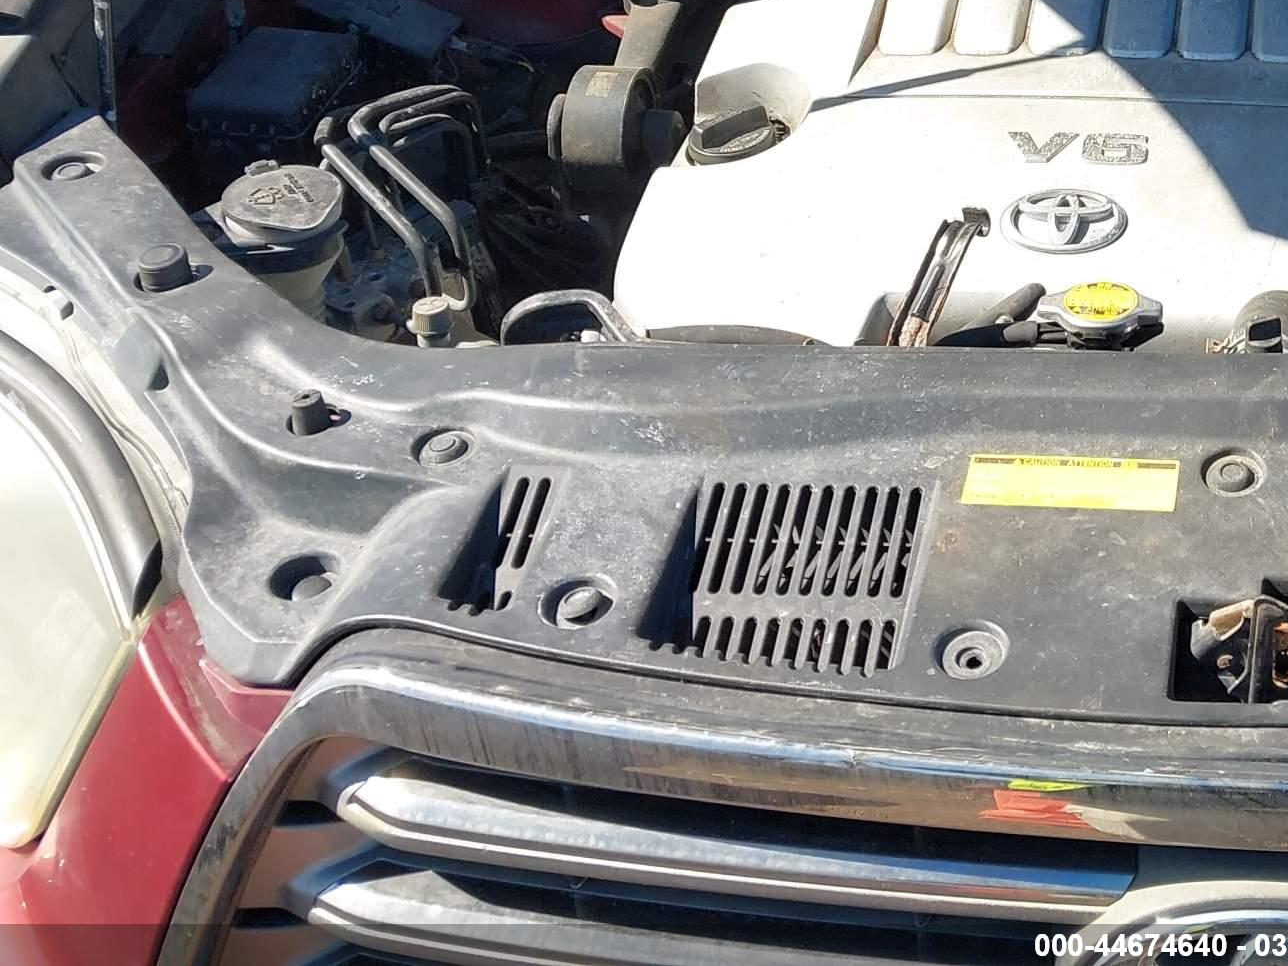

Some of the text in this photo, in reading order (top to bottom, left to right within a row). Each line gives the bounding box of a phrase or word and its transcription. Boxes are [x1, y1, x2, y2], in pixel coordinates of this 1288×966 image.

[1008, 131, 1149, 165] V6
[1023, 457, 1061, 466] CAUTION
[1067, 459, 1115, 467] ATTENTION
